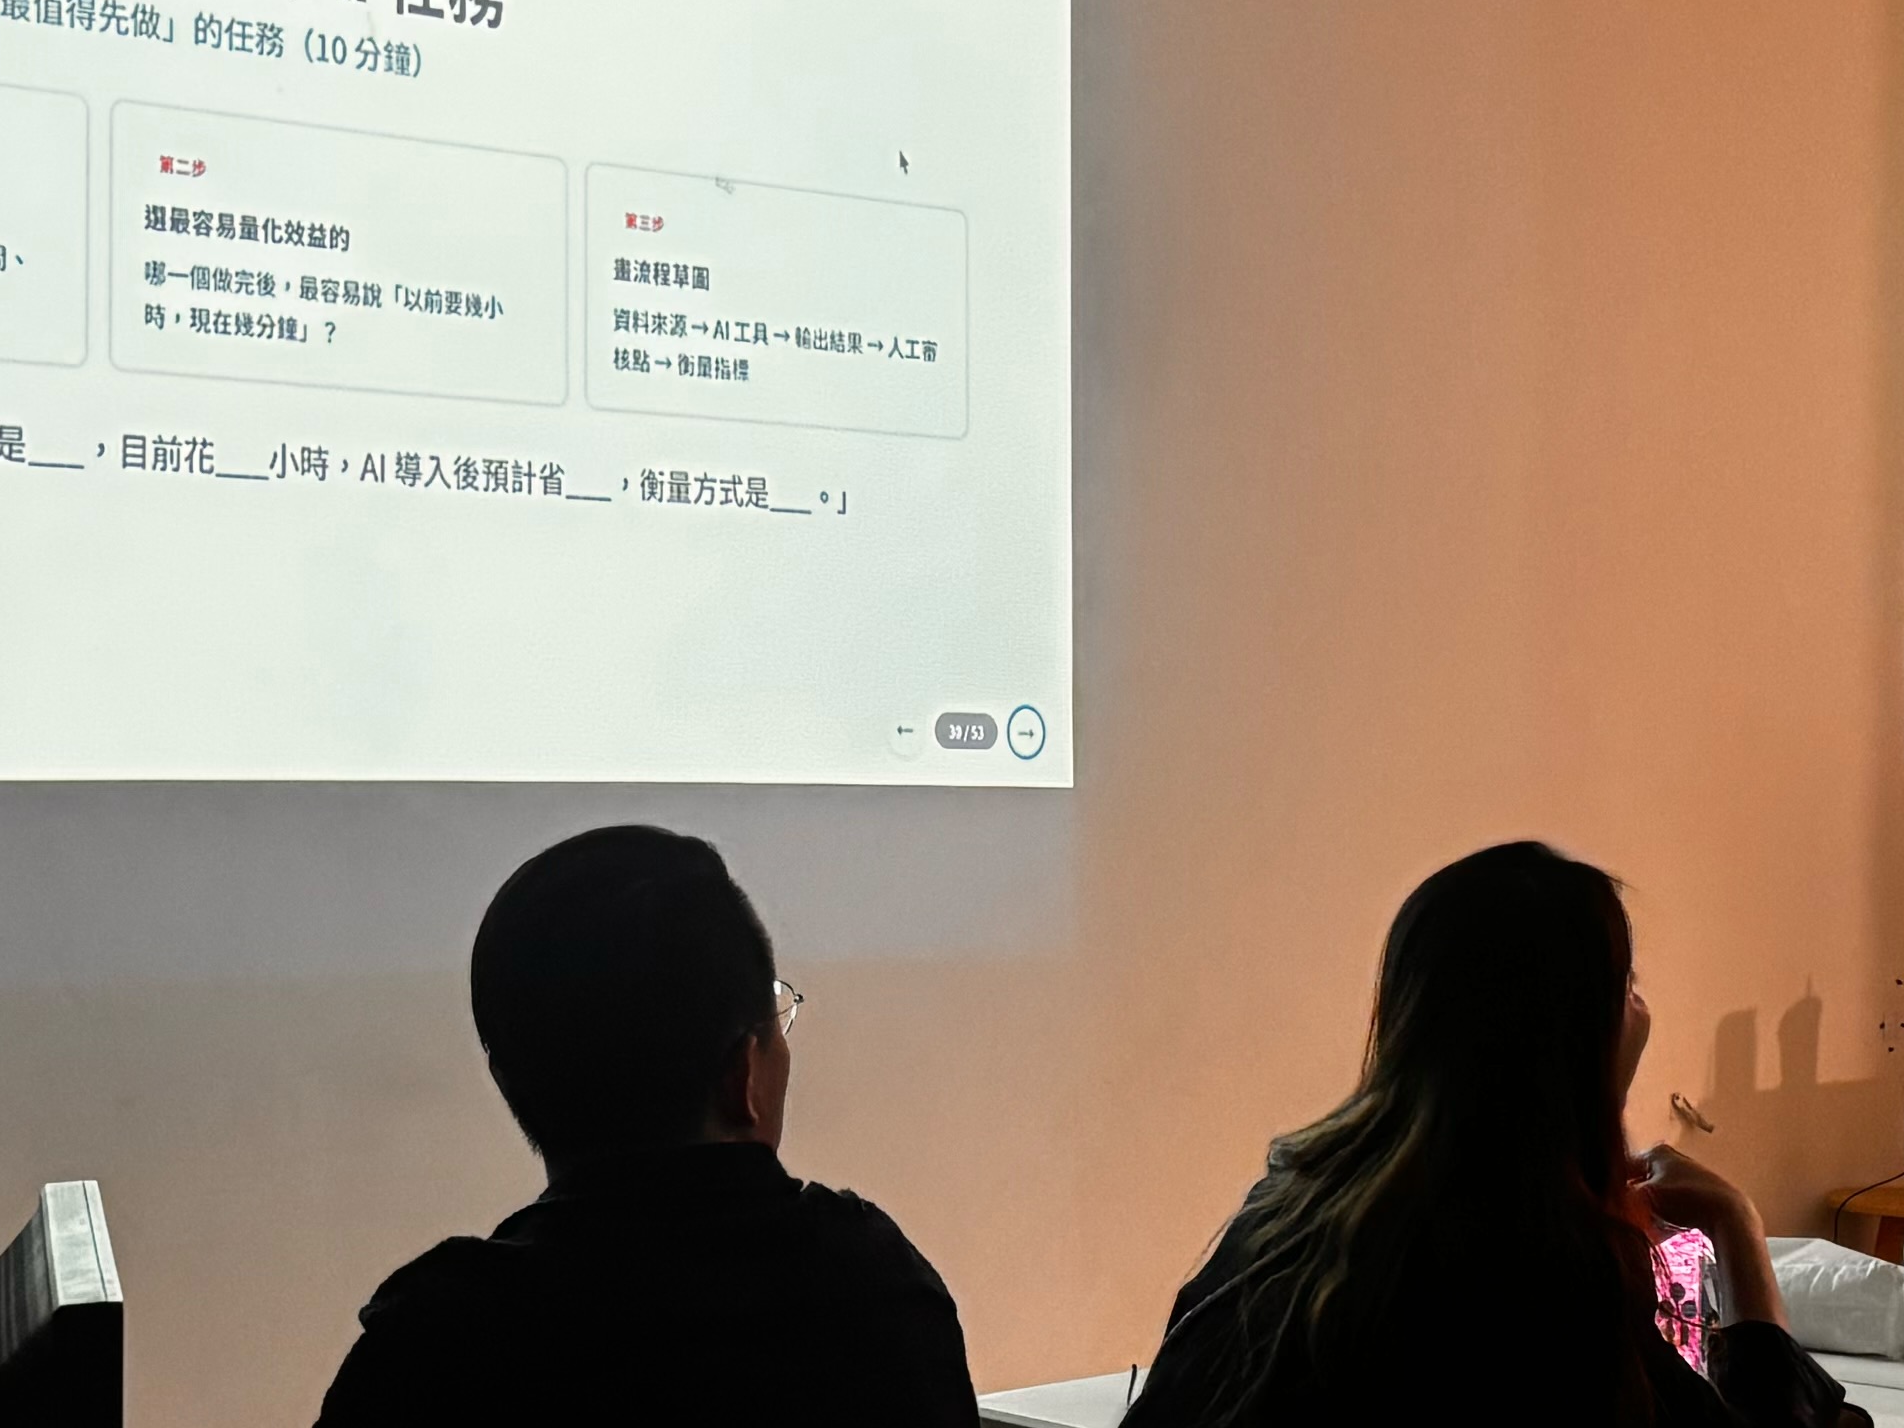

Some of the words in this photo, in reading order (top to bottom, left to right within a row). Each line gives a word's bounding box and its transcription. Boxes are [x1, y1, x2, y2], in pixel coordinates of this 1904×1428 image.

[159, 154, 207, 178] 第二步
[144, 203, 350, 253] 選最容易量化效益的
[624, 211, 665, 233] 第三步
[712, 319, 731, 342] AI
[733, 321, 769, 347] 工具
